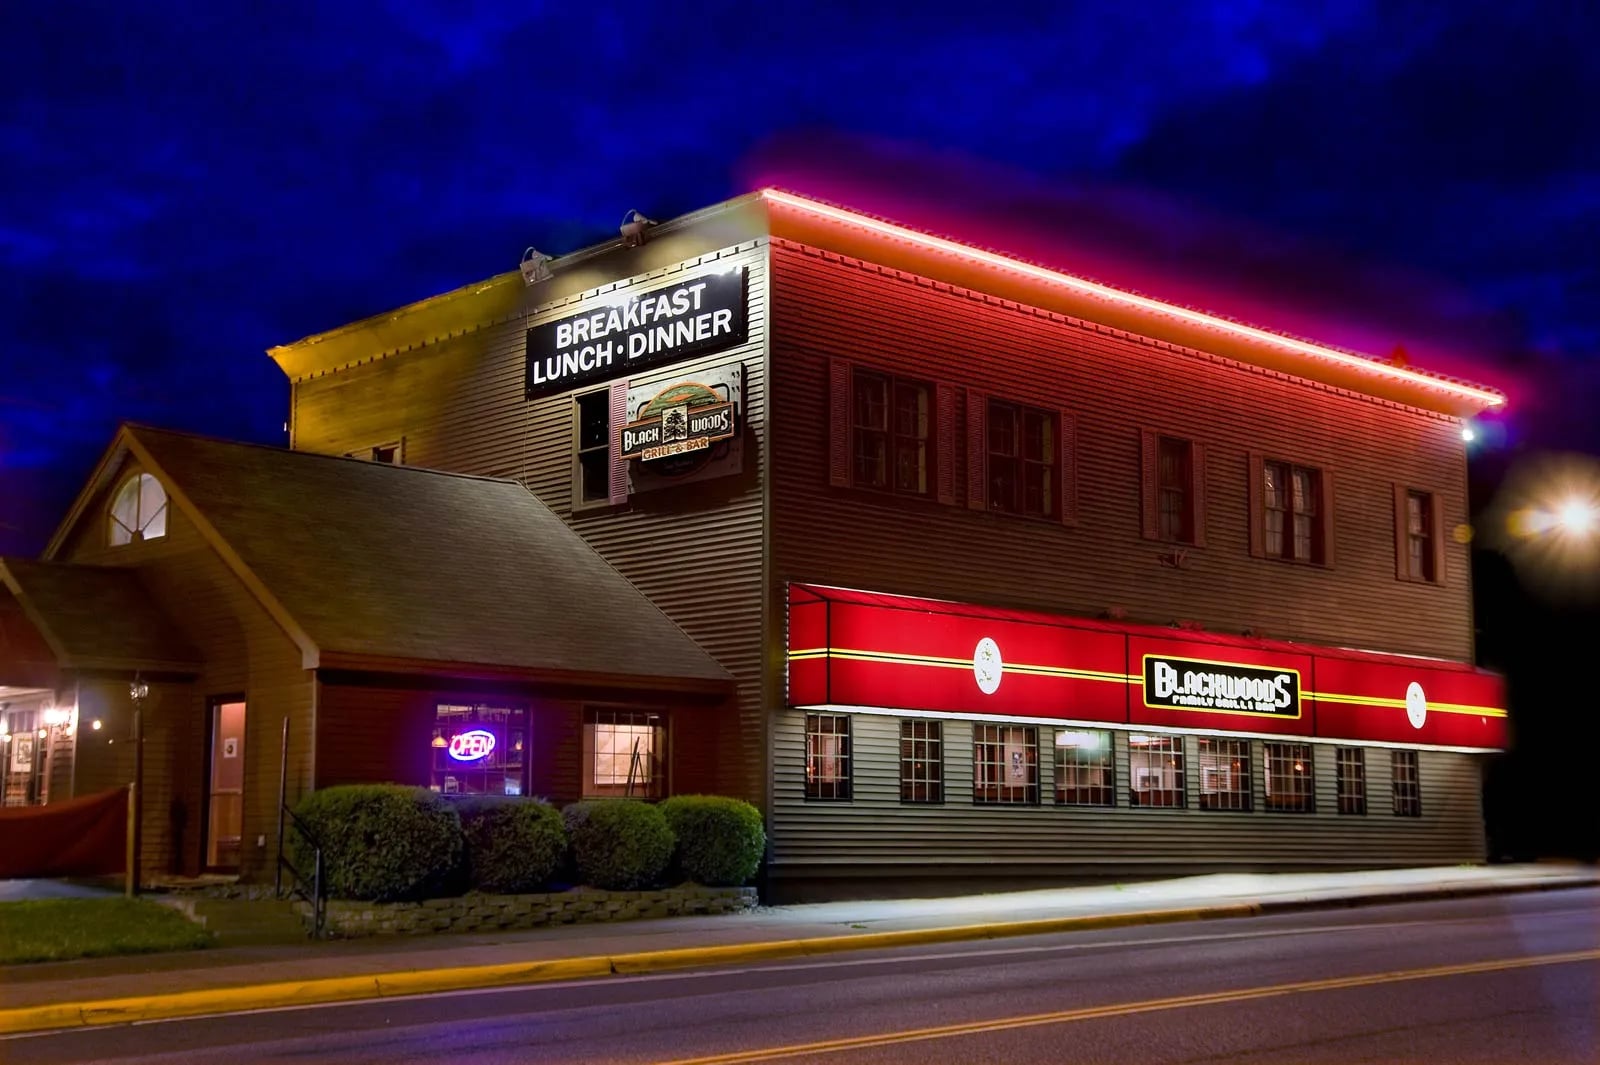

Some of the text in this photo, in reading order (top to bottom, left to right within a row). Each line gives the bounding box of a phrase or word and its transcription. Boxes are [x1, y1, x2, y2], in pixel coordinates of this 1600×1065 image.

[556, 283, 706, 349] BREAKFAST
[533, 309, 732, 385] LUNCH DINNER
[624, 409, 729, 452] BLACK WOODS
[643, 446, 671, 460] GRILL
[686, 437, 708, 450] BAR
[1154, 661, 1291, 708] BLACKWOODS
[451, 735, 491, 755] OPEN
